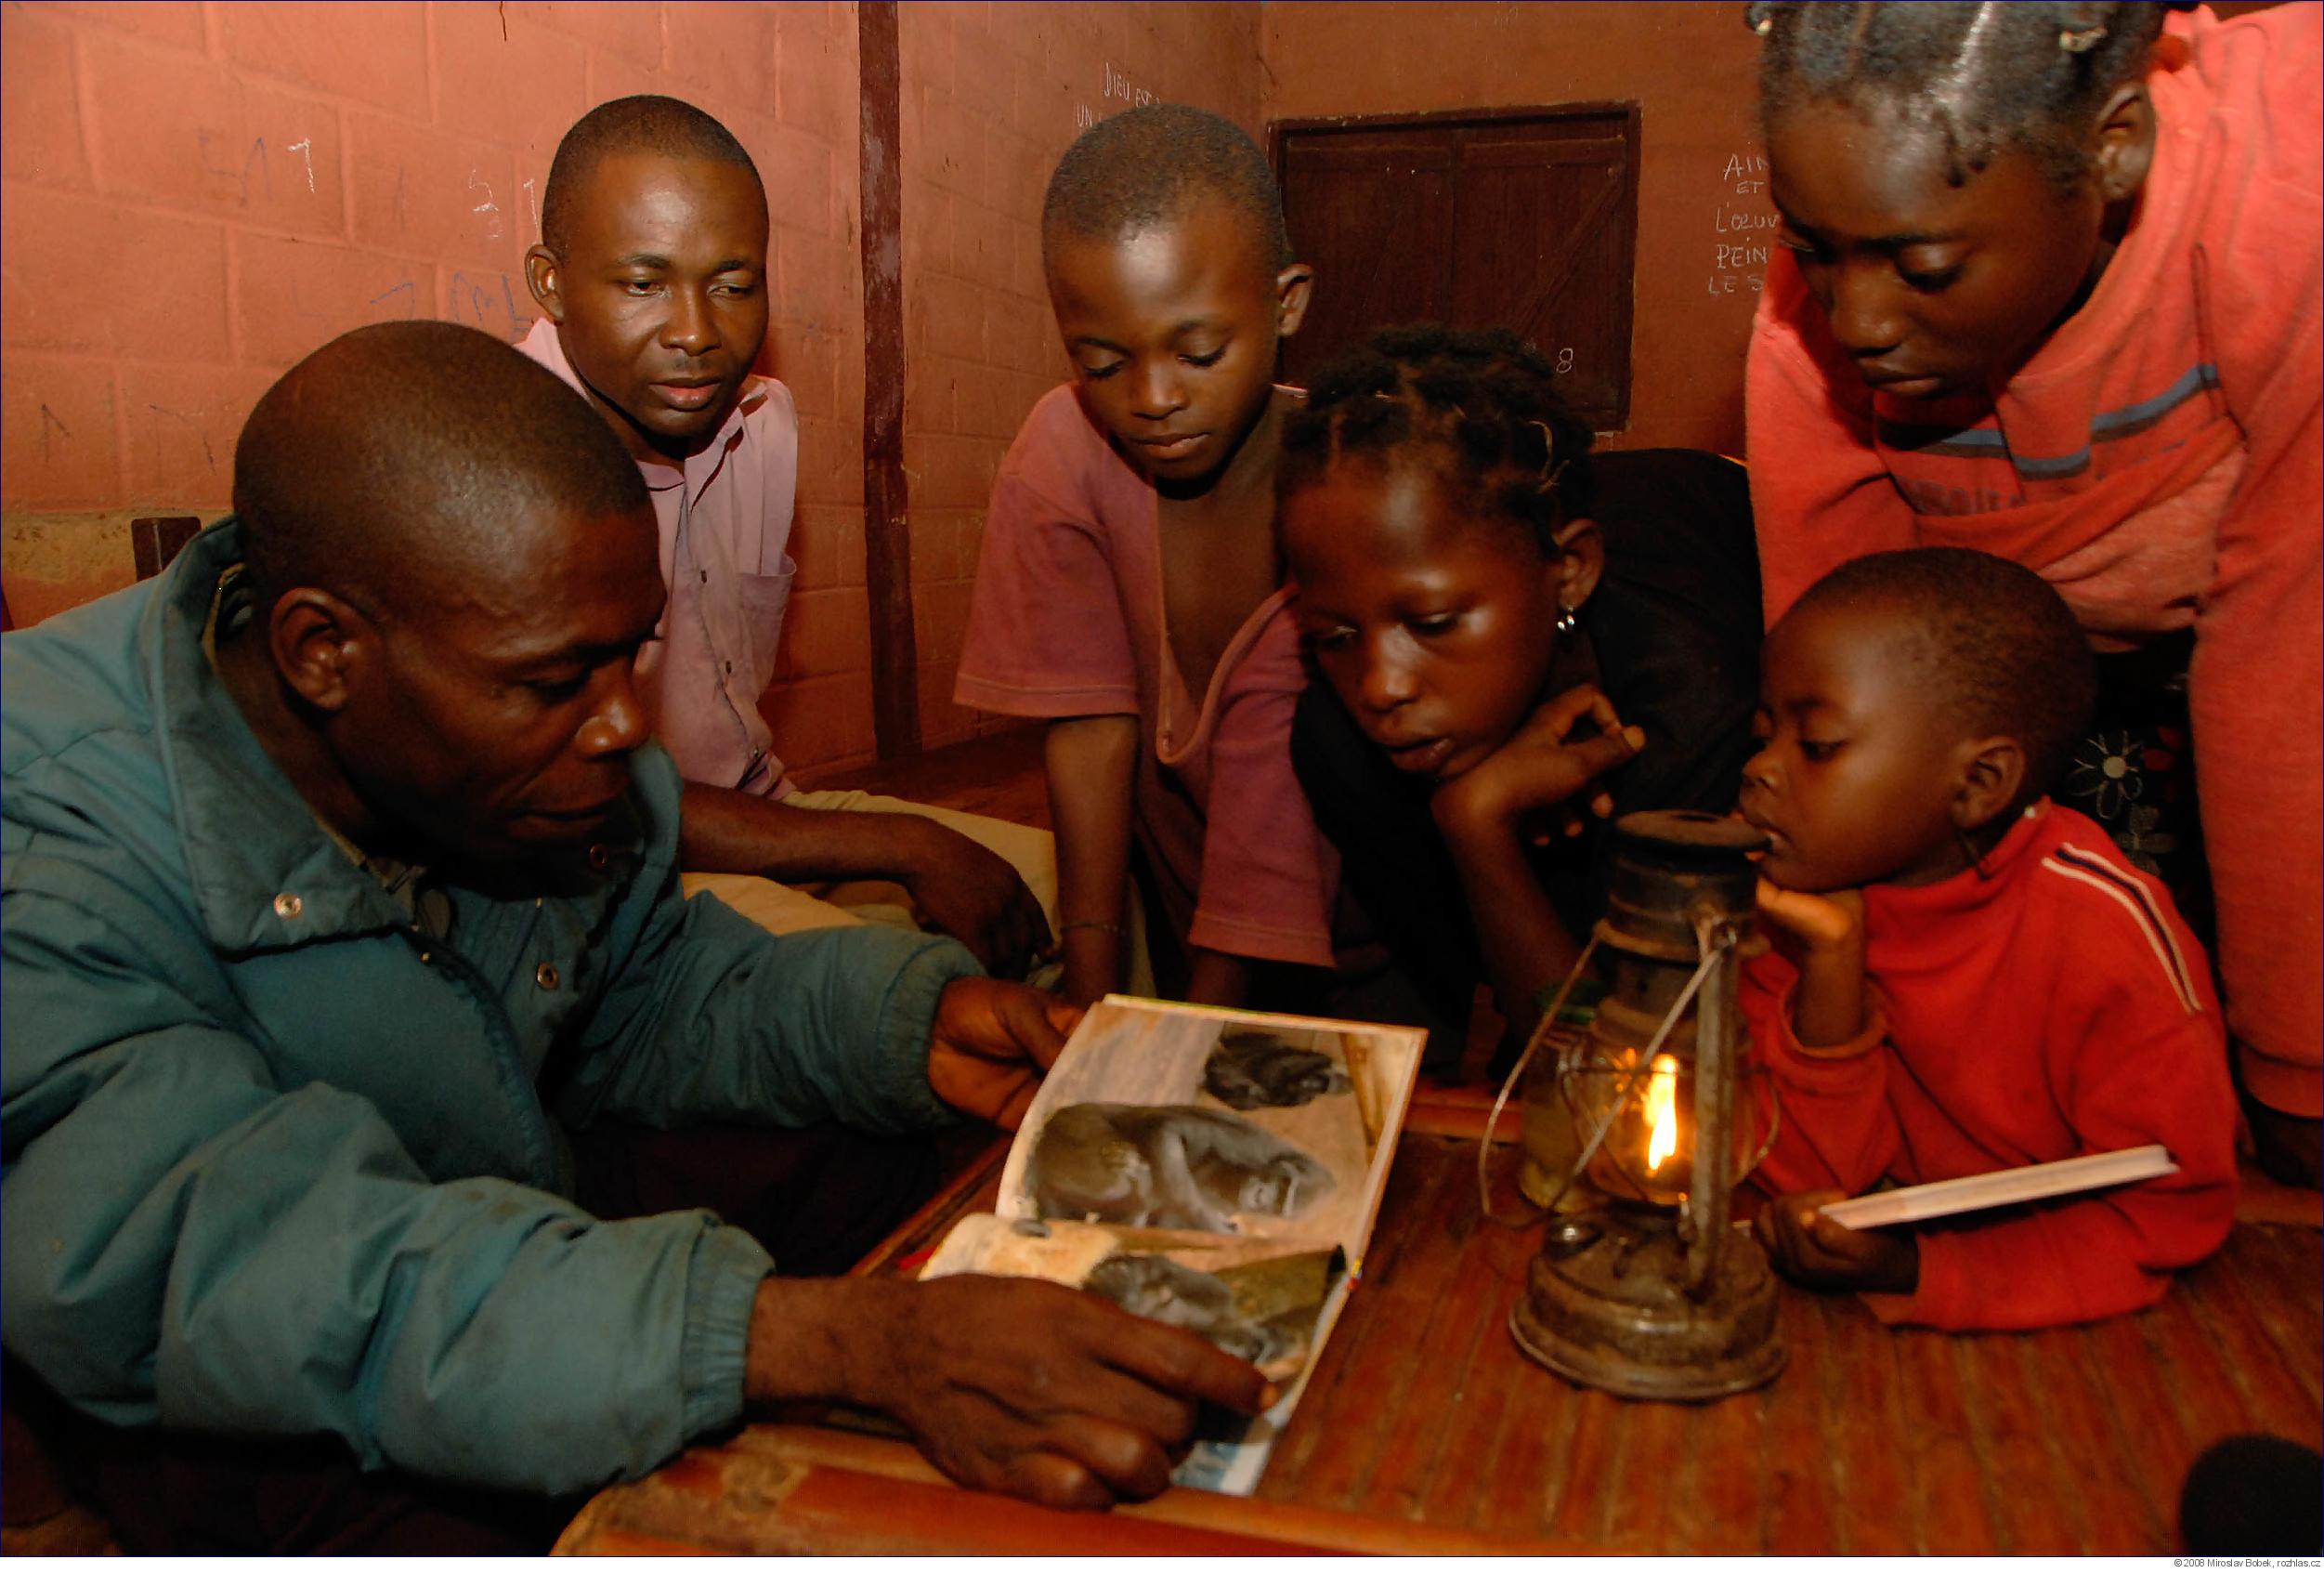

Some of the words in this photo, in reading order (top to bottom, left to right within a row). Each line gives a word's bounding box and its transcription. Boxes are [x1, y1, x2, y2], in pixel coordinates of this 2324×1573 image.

[1735, 179, 1766, 195] ET
[1707, 274, 1738, 296] LE
[1555, 347, 1574, 374] 8
